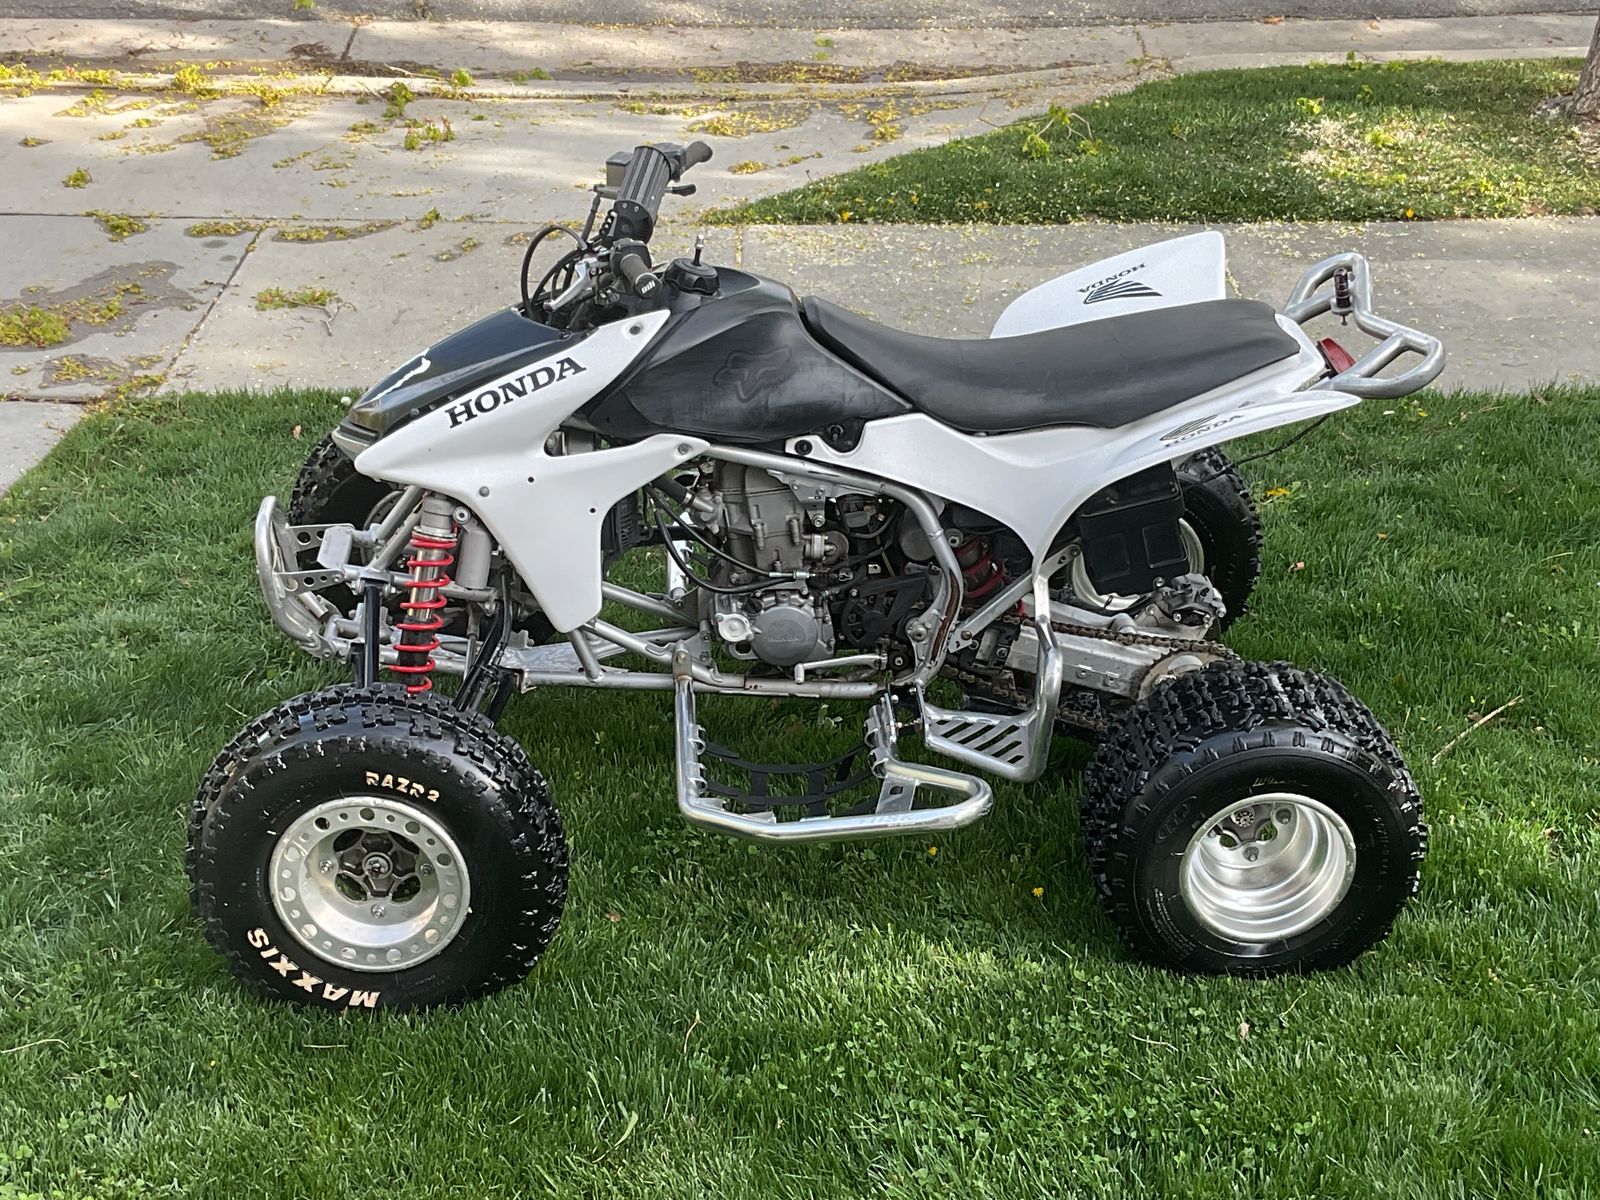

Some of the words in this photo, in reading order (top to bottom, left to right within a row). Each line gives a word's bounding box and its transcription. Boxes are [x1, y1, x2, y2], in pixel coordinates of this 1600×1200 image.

[1077, 263, 1147, 294] HONDA
[445, 356, 588, 429] HONDA
[365, 771, 425, 798] RAZR
[427, 789, 440, 803] 2
[247, 927, 381, 1008] MAXXIS
